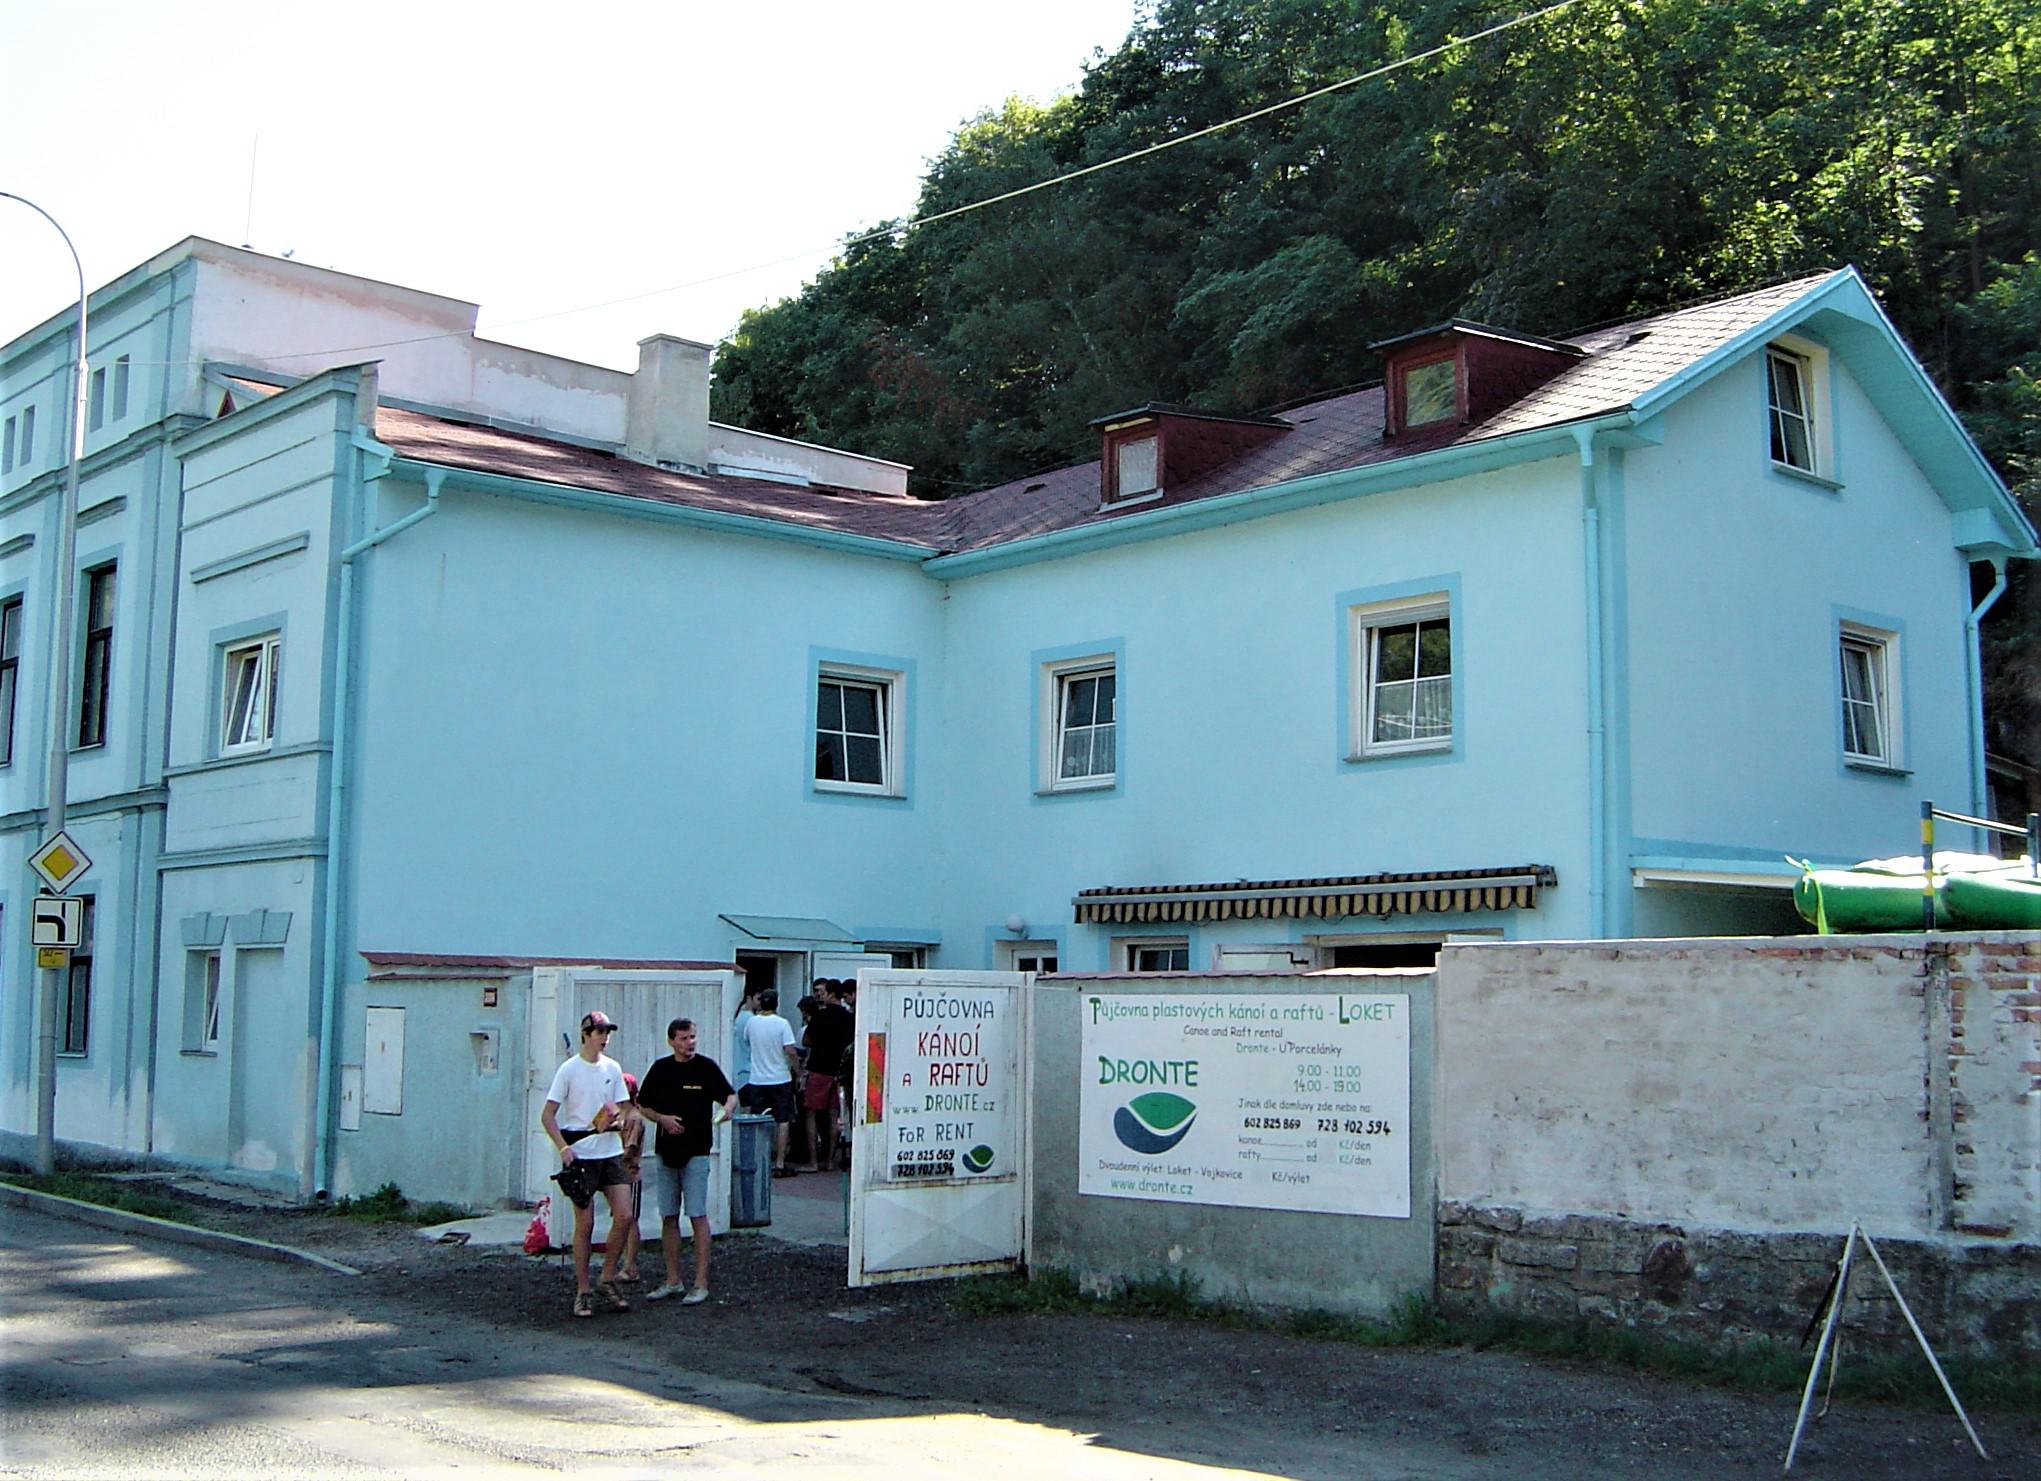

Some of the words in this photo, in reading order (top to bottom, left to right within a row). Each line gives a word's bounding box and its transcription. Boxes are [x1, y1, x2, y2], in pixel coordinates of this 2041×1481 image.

[903, 991, 994, 1019] PŮJČOVNA
[1089, 997, 1149, 1024] Půjčovna
[1153, 1002, 1223, 1023] plastových
[1229, 1003, 1265, 1018] kánoí
[1271, 1007, 1278, 1018] a
[1284, 1004, 1324, 1020] raftů
[1339, 996, 1395, 1024] LOKET
[1183, 1026, 1209, 1036] Canoe
[1211, 1027, 1228, 1037] and
[1230, 1027, 1251, 1037] Raft
[1254, 1028, 1283, 1038] rental
[918, 1024, 980, 1057] KÁNOÍ
[1236, 1043, 1269, 1053] Dronte
[902, 1073, 912, 1087] A
[929, 1057, 988, 1086] RAFTŮ
[1098, 1056, 1199, 1086] DRONTE
[1263, 1098, 1277, 1110] dle
[1317, 1102, 1333, 1112] zde
[1336, 1103, 1357, 1113] nebo
[936, 1122, 974, 1141] RENT
[1244, 1118, 1261, 1129] 602
[1264, 1118, 1281, 1130] 825
[1283, 1119, 1301, 1130] 869
[1317, 1119, 1338, 1133] 728
[1344, 1119, 1364, 1134] 102
[1366, 1120, 1391, 1136] 594
[1306, 1139, 1317, 1148] od
[897, 1150, 914, 1161] 602
[917, 1150, 935, 1161] 825
[1306, 1153, 1317, 1163] od
[897, 1163, 915, 1177] 728
[935, 1162, 955, 1176] 594
[1167, 1164, 1191, 1176] Loket
[1110, 1178, 1193, 1195] www.dronte.cz
